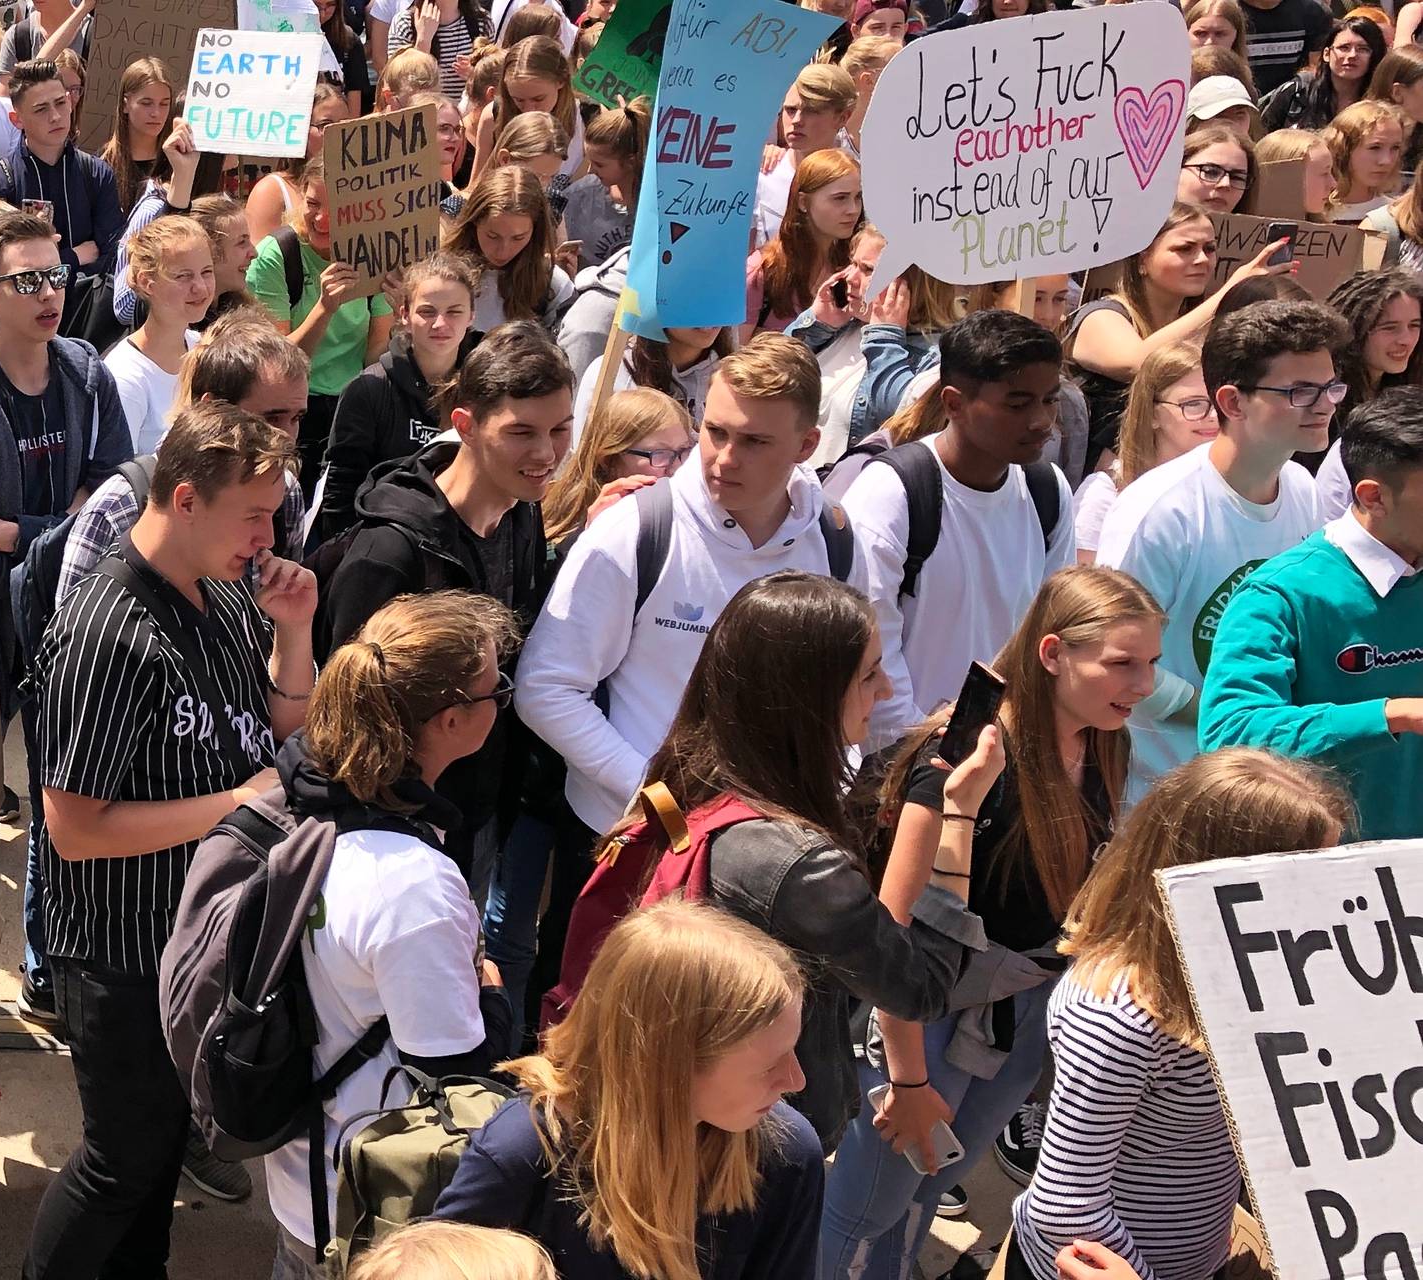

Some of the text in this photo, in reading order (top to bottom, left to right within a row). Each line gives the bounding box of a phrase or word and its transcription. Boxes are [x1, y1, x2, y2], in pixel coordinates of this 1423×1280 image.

[200, 33, 232, 48] NO
[197, 52, 302, 77] EARTH
[714, 73, 738, 92] es
[906, 22, 1125, 139] Let's Fuck
[192, 81, 231, 99] NO
[188, 105, 306, 145] FUTURE
[341, 112, 427, 171] KLIMA
[336, 163, 422, 195] POLITIK
[913, 148, 1125, 224] instead of our
[337, 181, 440, 227] MUSS SICH
[664, 179, 749, 224] Zukunft
